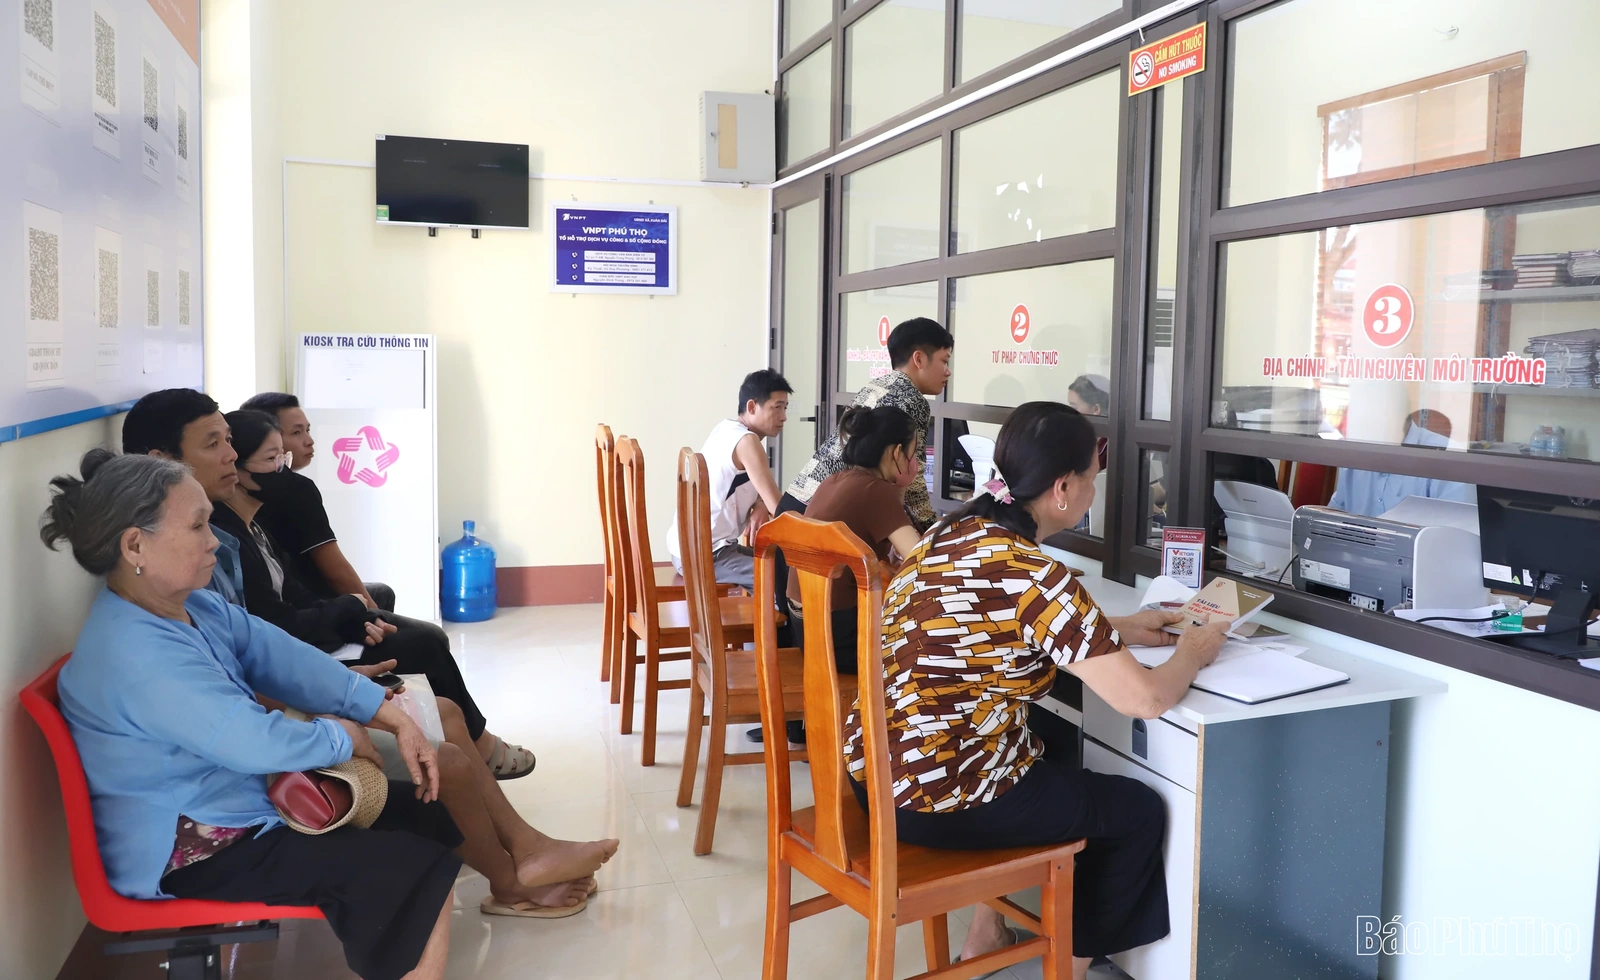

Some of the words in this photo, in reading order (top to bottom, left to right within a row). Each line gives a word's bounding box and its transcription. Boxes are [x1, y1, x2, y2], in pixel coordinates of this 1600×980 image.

[1154, 44, 1168, 64] CẤM
[1168, 40, 1181, 59] HÚT
[1182, 29, 1202, 53] THUỐC
[1158, 66, 1168, 79] NO
[1168, 55, 1197, 75] SMOKING
[582, 226, 606, 234] VNPT
[608, 226, 627, 235] PHÚ
[629, 228, 648, 237] THỌ
[1014, 312, 1027, 337] 2
[1372, 296, 1401, 334] 3
[303, 335, 334, 347] KIOSK
[336, 336, 354, 347] TRA
[357, 334, 377, 348] CỨU
[379, 335, 411, 348] THÔNG
[413, 337, 429, 348] TIN
[881, 322, 887, 342] 1
[992, 350, 1000, 363] TƯ
[1001, 348, 1017, 364] PHÁP
[1019, 346, 1040, 365] CHỨNG
[1041, 350, 1059, 369] THỰC
[1263, 357, 1283, 381] ĐỊA
[1286, 354, 1326, 378] CHÍNH
[1339, 354, 1360, 379] TÀI
[1364, 354, 1425, 381] NGUYÊN
[1433, 354, 1465, 382] MÔI
[1471, 352, 1545, 384] TRƯỜNG
